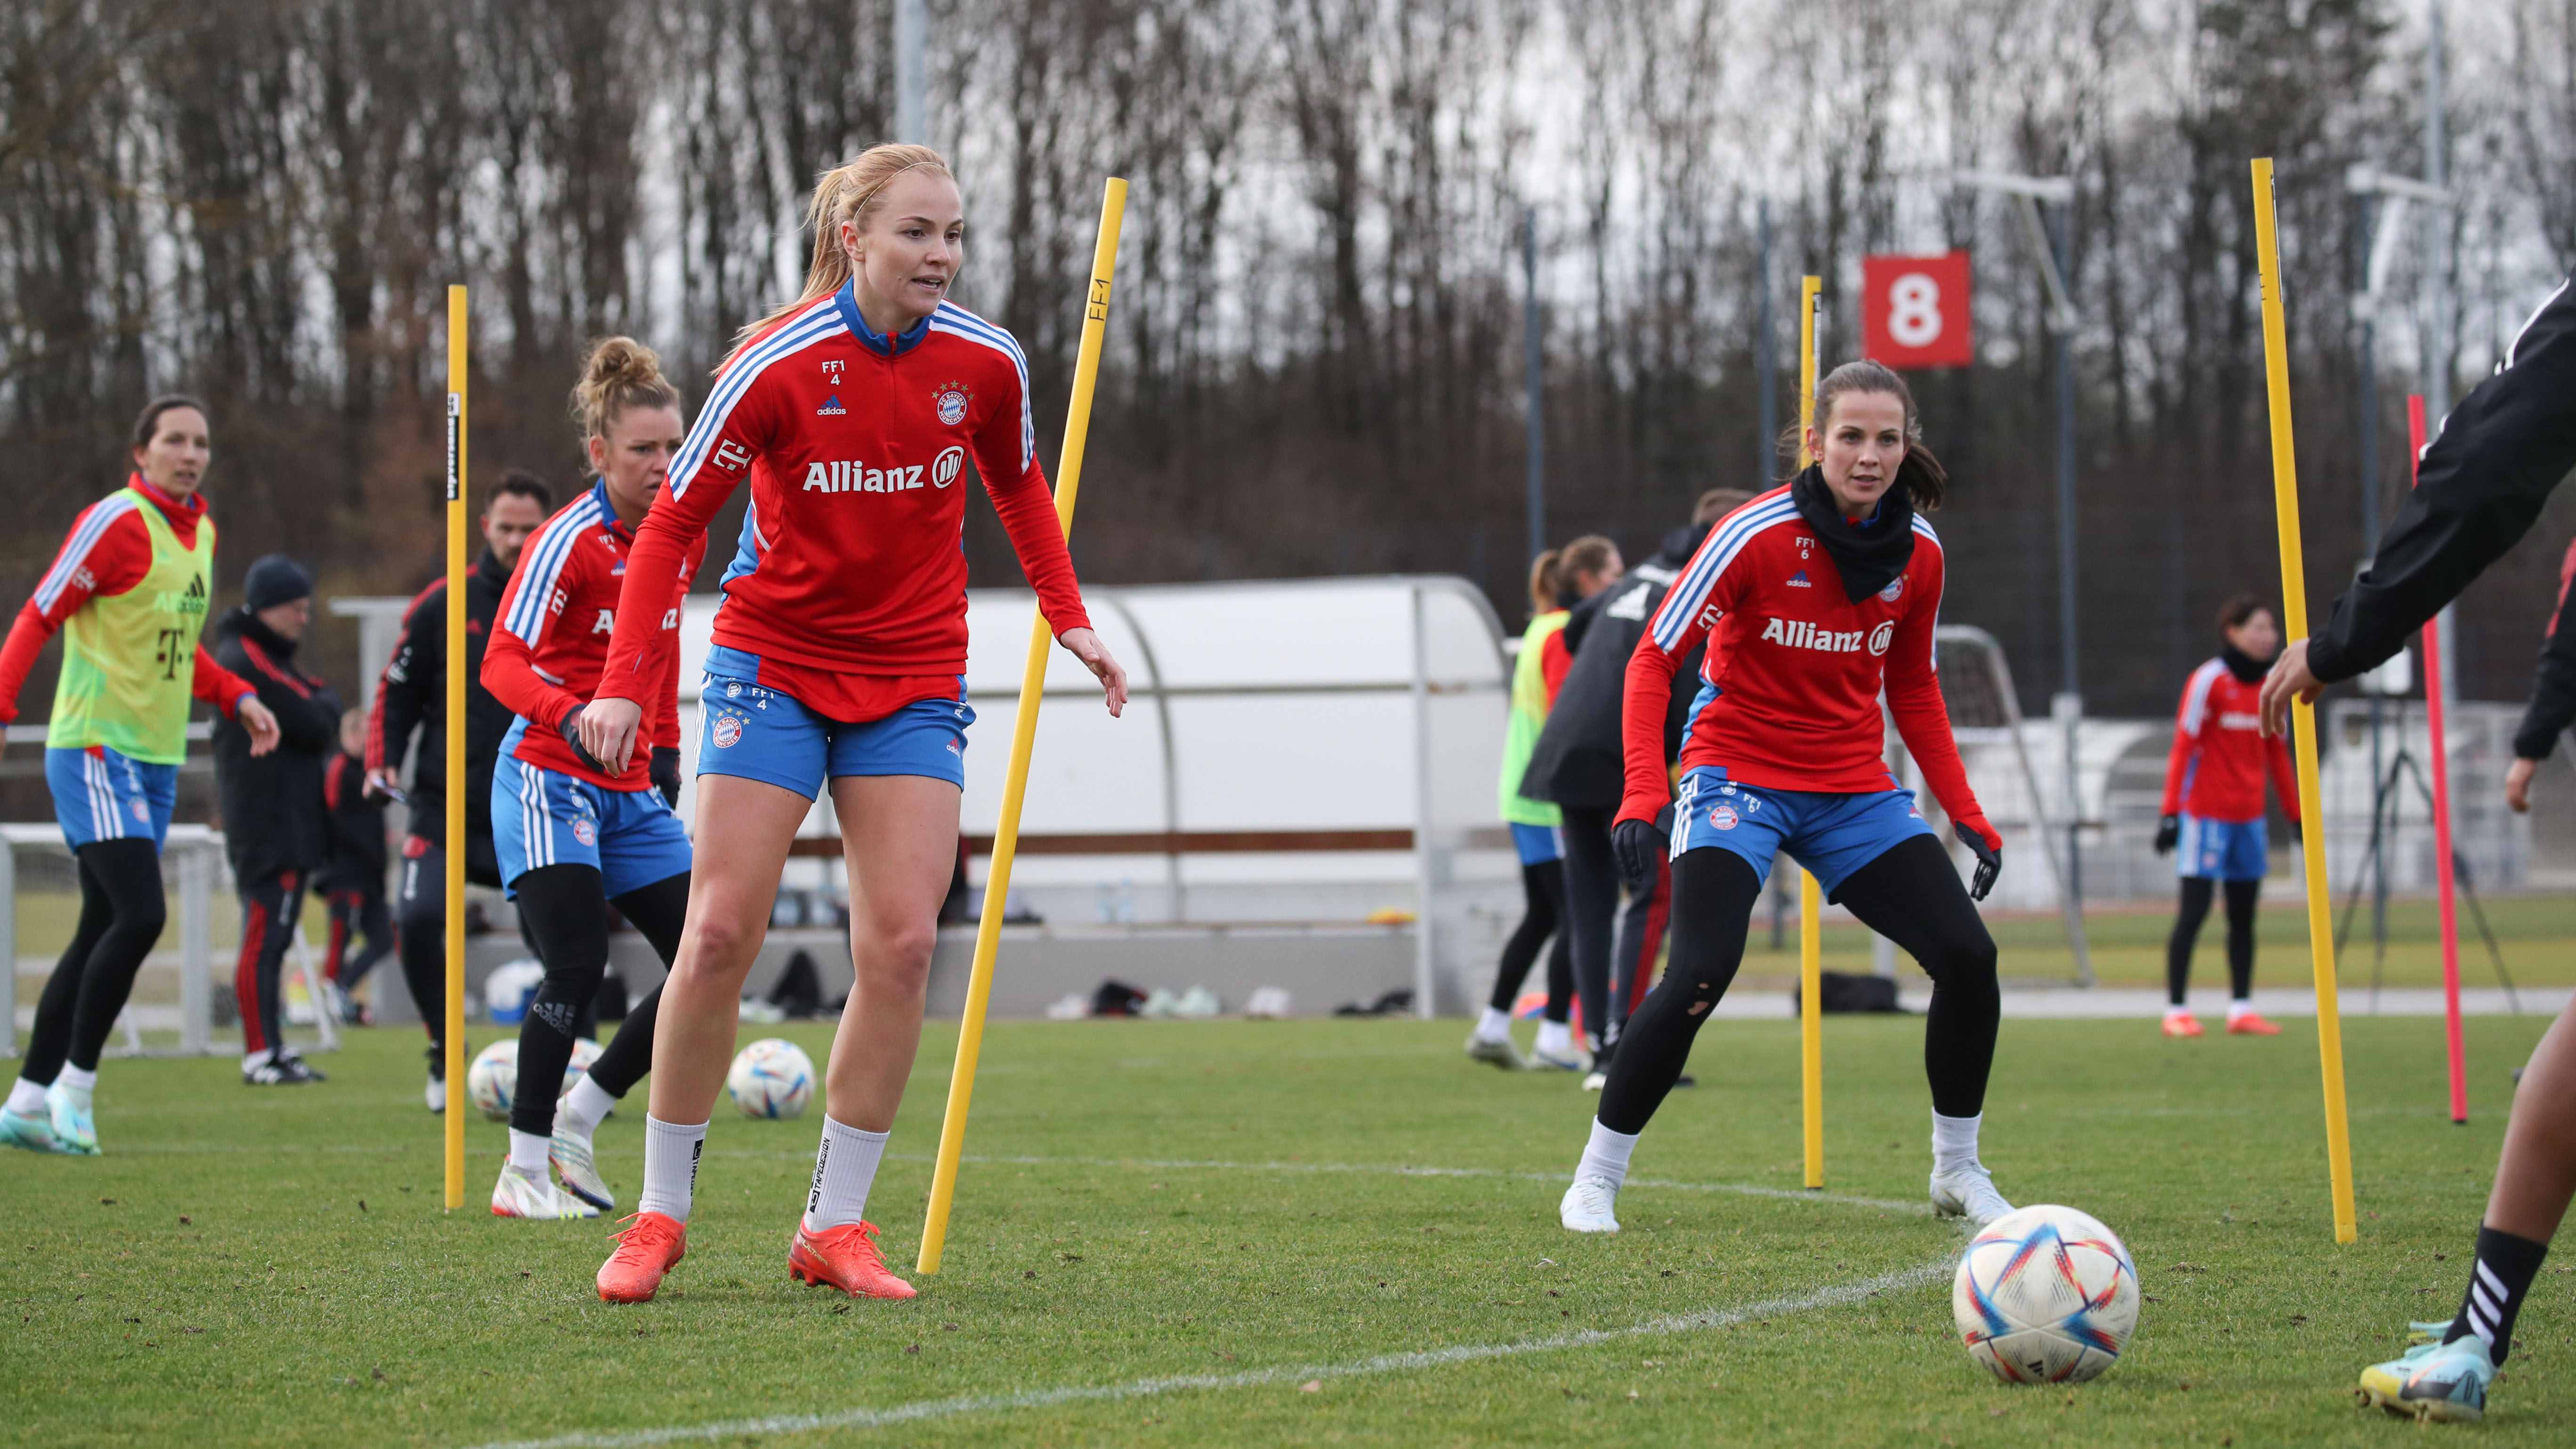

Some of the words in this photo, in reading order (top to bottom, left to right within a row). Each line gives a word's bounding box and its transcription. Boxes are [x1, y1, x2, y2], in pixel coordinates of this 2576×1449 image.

[1089, 278, 1110, 321] FF1
[1887, 272, 1943, 348] 8
[821, 360, 845, 373] FF1
[830, 374, 840, 386] 4
[940, 397, 946, 406] FC
[946, 393, 965, 406] BAYERN
[817, 407, 847, 415] adidas
[802, 460, 924, 493] Allianz
[1795, 536, 1815, 549] FF1
[1800, 549, 1810, 560] 6
[1786, 579, 1812, 588] adidas
[1761, 617, 1864, 653] Allianz
[752, 687, 774, 699] FF1
[757, 699, 767, 710] 4
[722, 718, 740, 731] BAYERN
[1743, 793, 1761, 810] FF1
